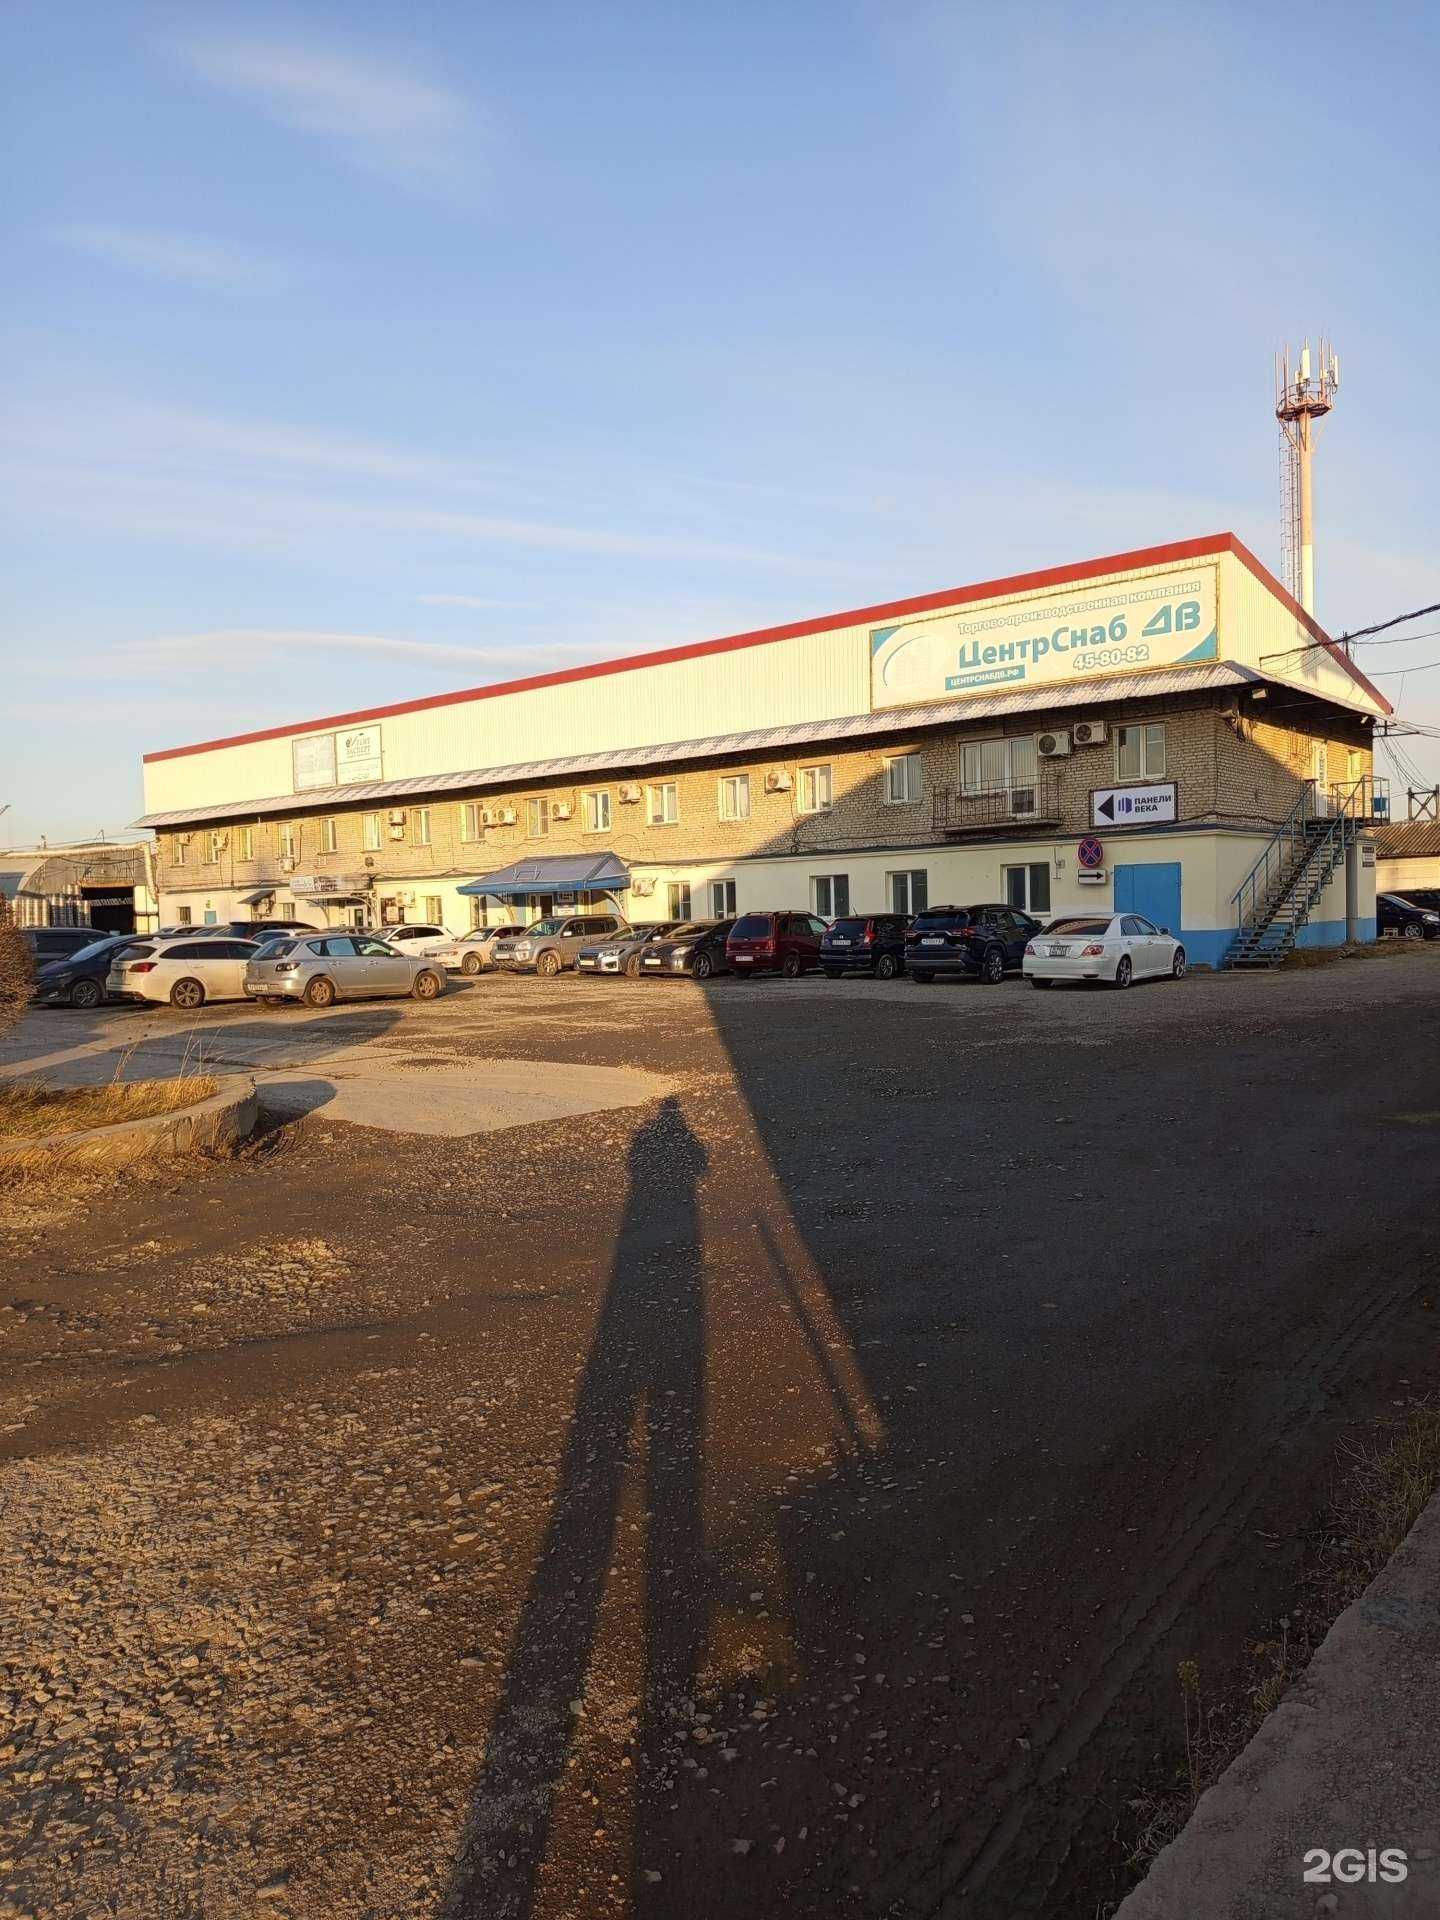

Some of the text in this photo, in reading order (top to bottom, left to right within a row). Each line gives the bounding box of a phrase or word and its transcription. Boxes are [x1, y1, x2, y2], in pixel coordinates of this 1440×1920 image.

[1127, 580, 1201, 604] компания
[959, 613, 1128, 668] ЦентрСнаб
[1073, 643, 1150, 671] 45-80-82
[1134, 794, 1172, 805] ПАНЕЛИ
[1134, 803, 1158, 813] ВЕКА
